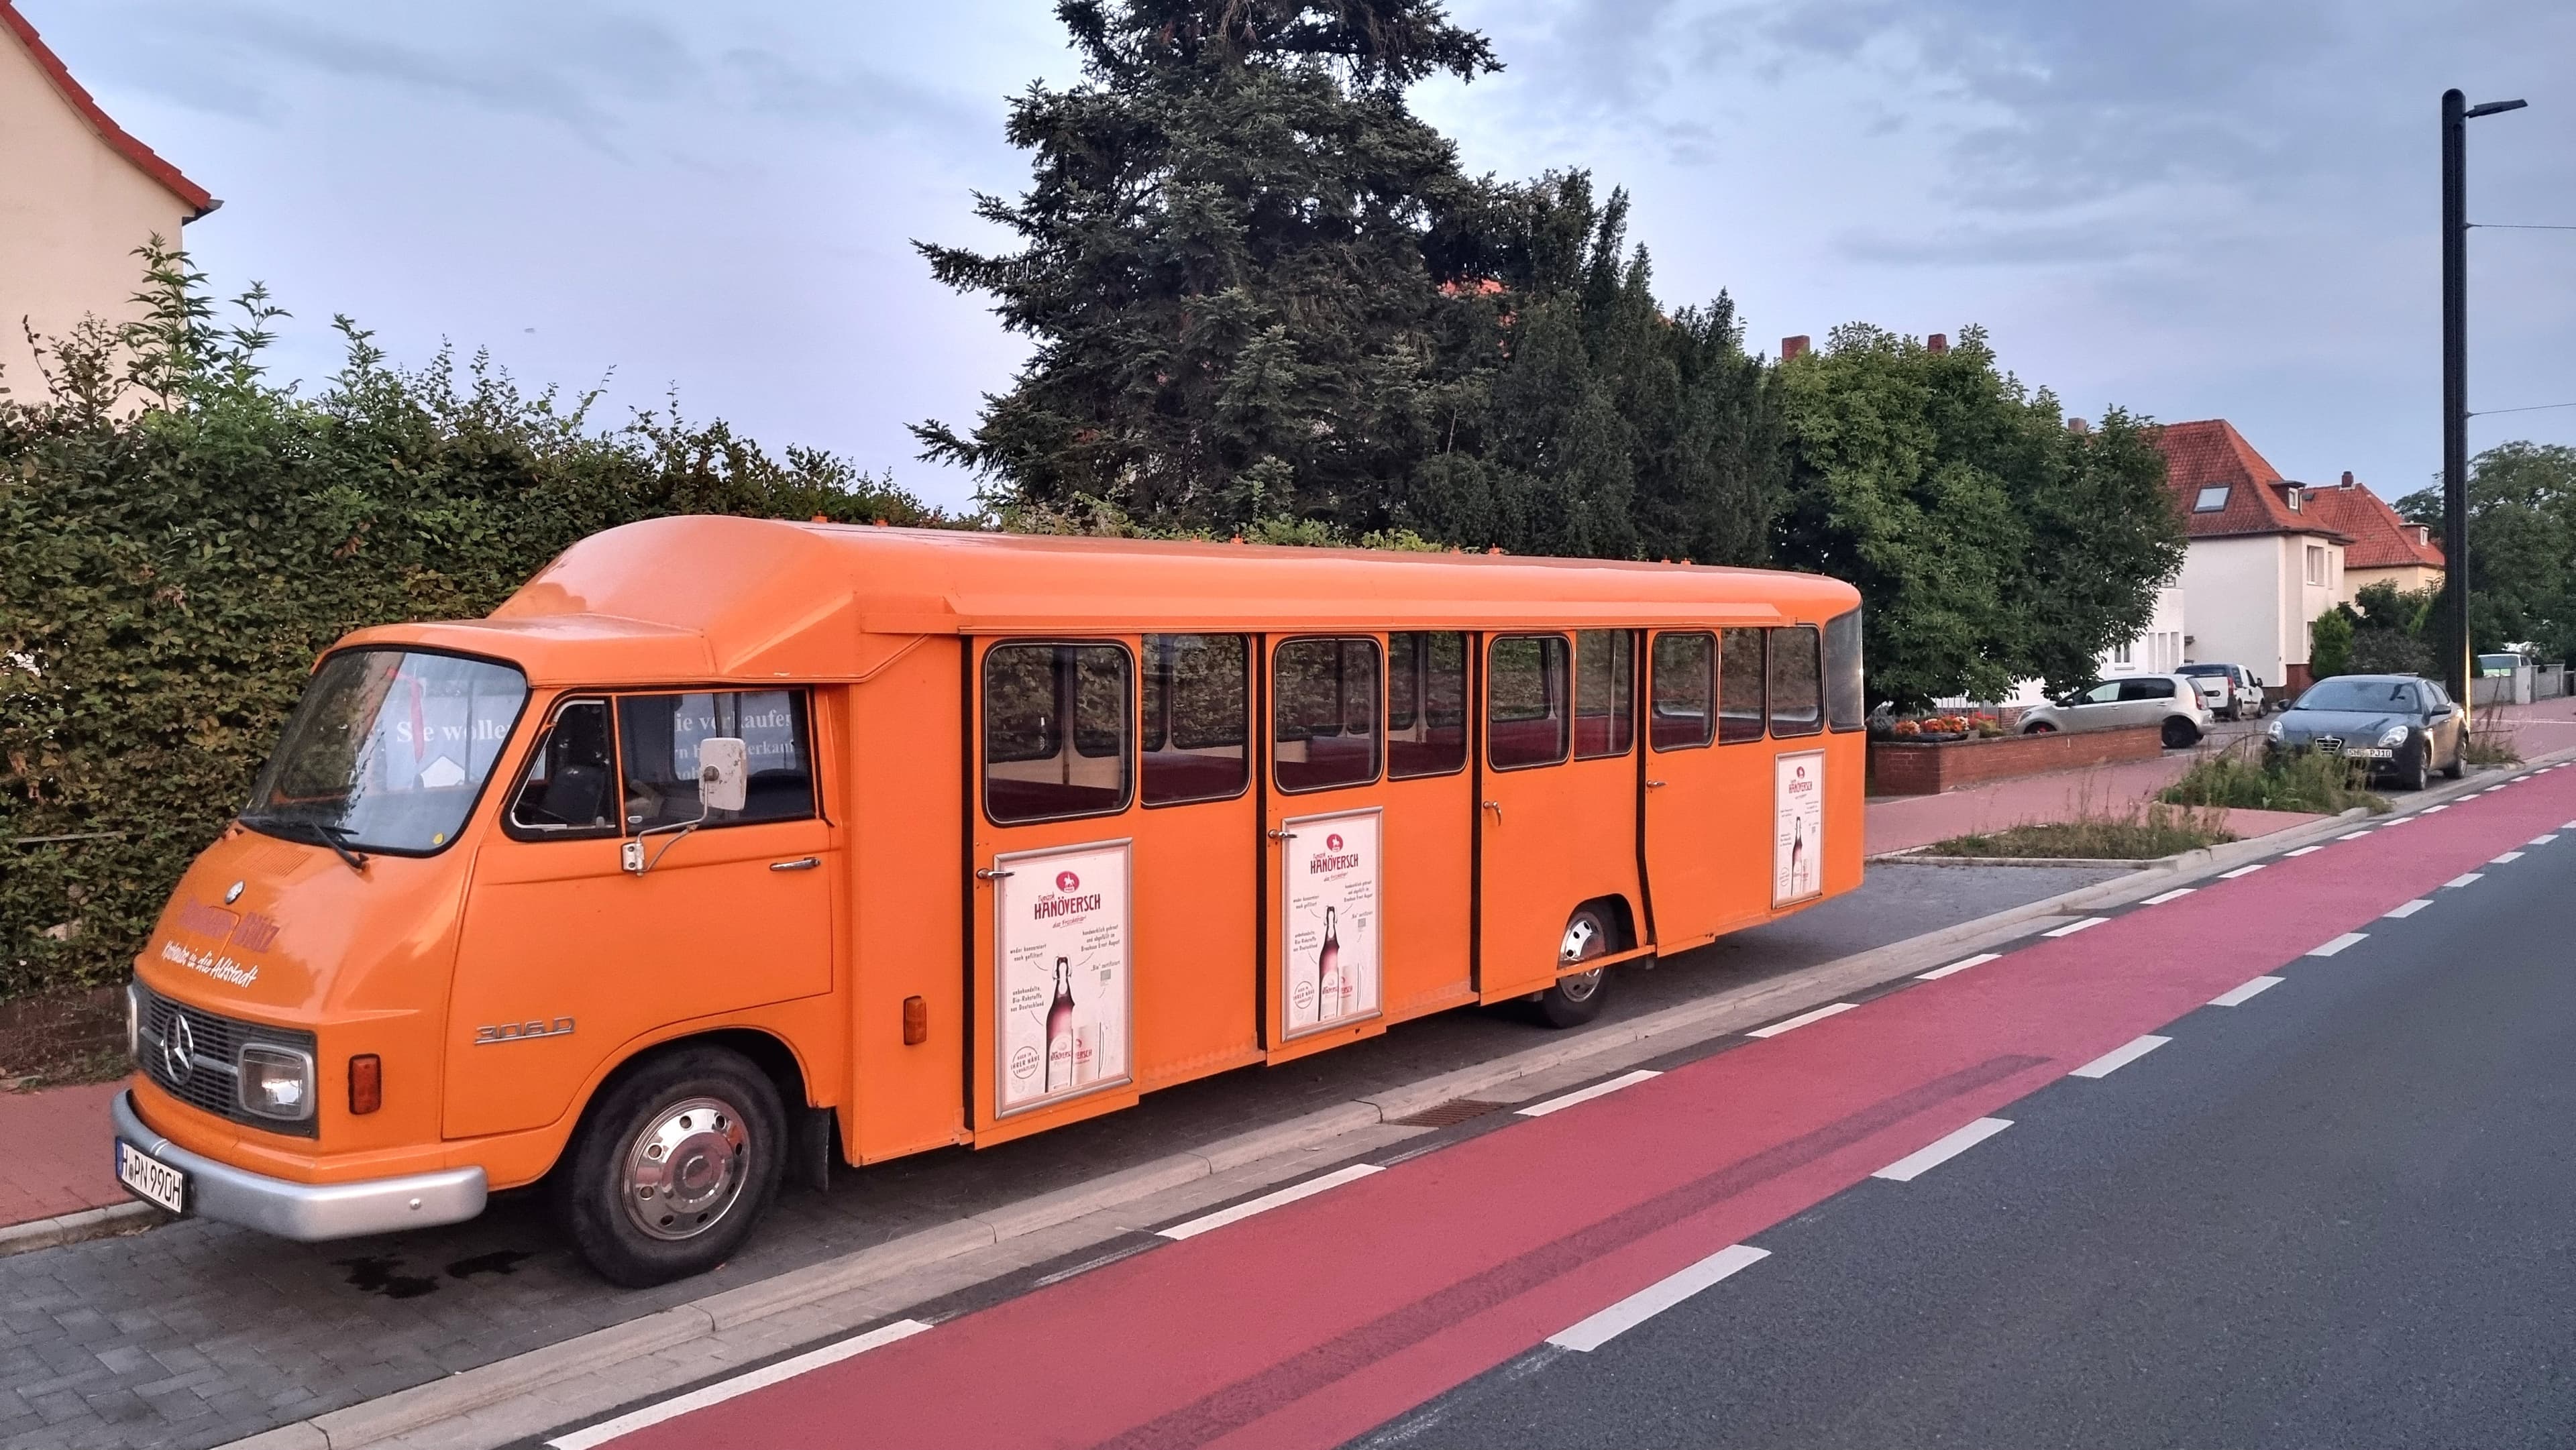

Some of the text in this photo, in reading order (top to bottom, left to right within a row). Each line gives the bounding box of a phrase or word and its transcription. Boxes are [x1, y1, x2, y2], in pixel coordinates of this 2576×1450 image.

[397, 720, 511, 742] Se wolle
[748, 740, 795, 755] erkauf
[1310, 853, 1358, 875] HANÖVERSCH
[1034, 893, 1101, 920] HANÖVERSCH
[209, 956, 259, 988] Altstadt
[134, 1154, 148, 1189] PN
[150, 1164, 180, 1207] 990H
